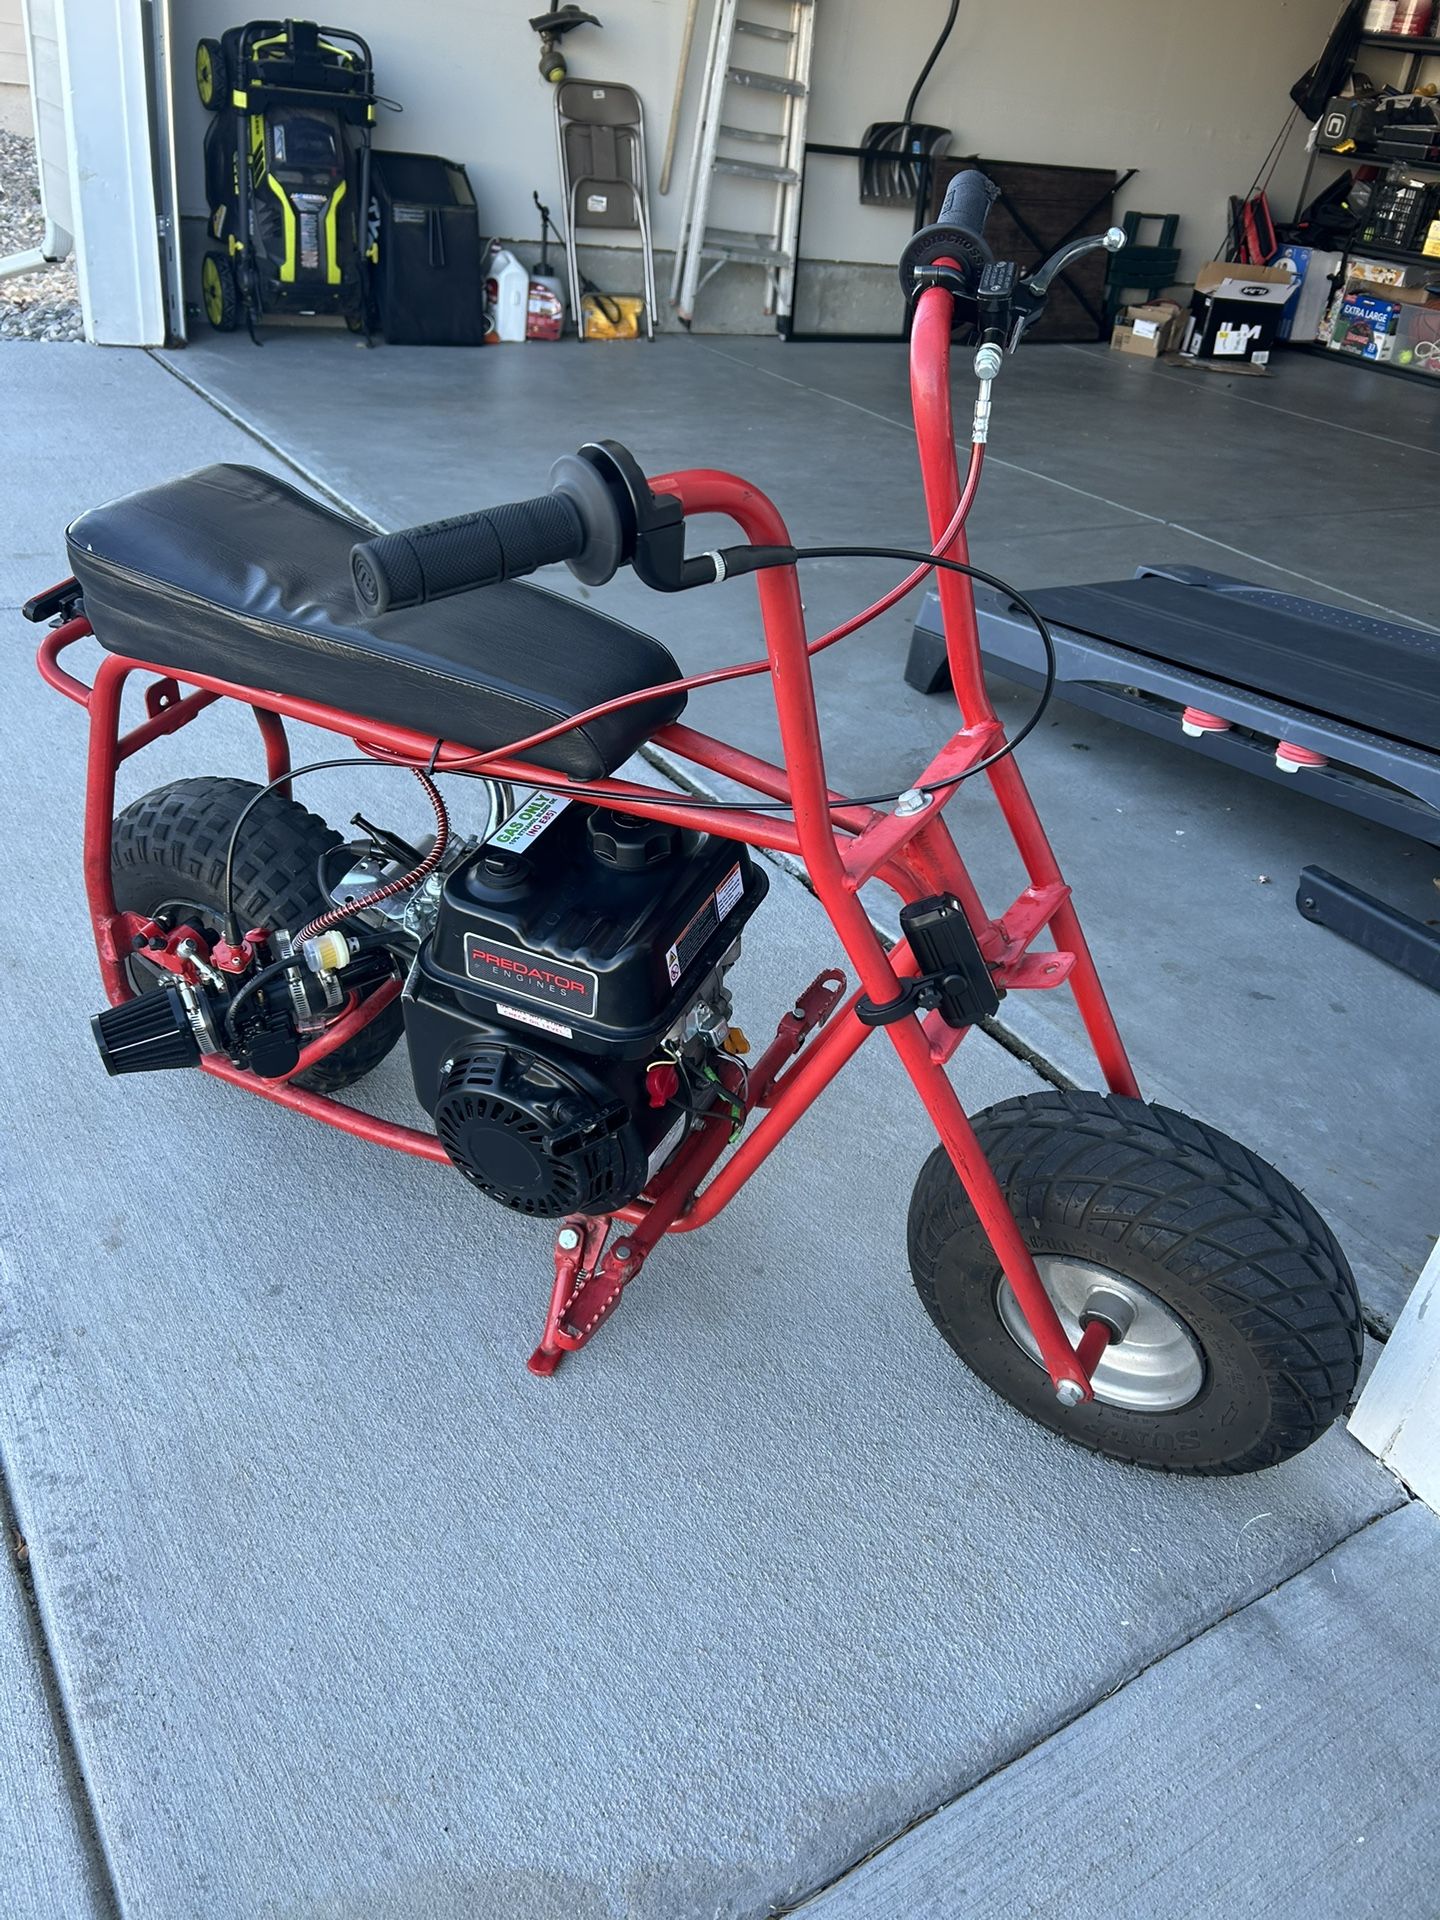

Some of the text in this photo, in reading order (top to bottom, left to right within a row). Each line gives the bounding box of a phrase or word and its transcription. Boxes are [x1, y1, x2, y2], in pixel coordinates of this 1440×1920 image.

[1344, 304, 1388, 323] EXTRA LARGE
[496, 794, 550, 843] GAS ONLY
[525, 809, 558, 837] (NO E85)
[472, 948, 586, 995] PREDATOR
[492, 966, 567, 997] ENGINES
